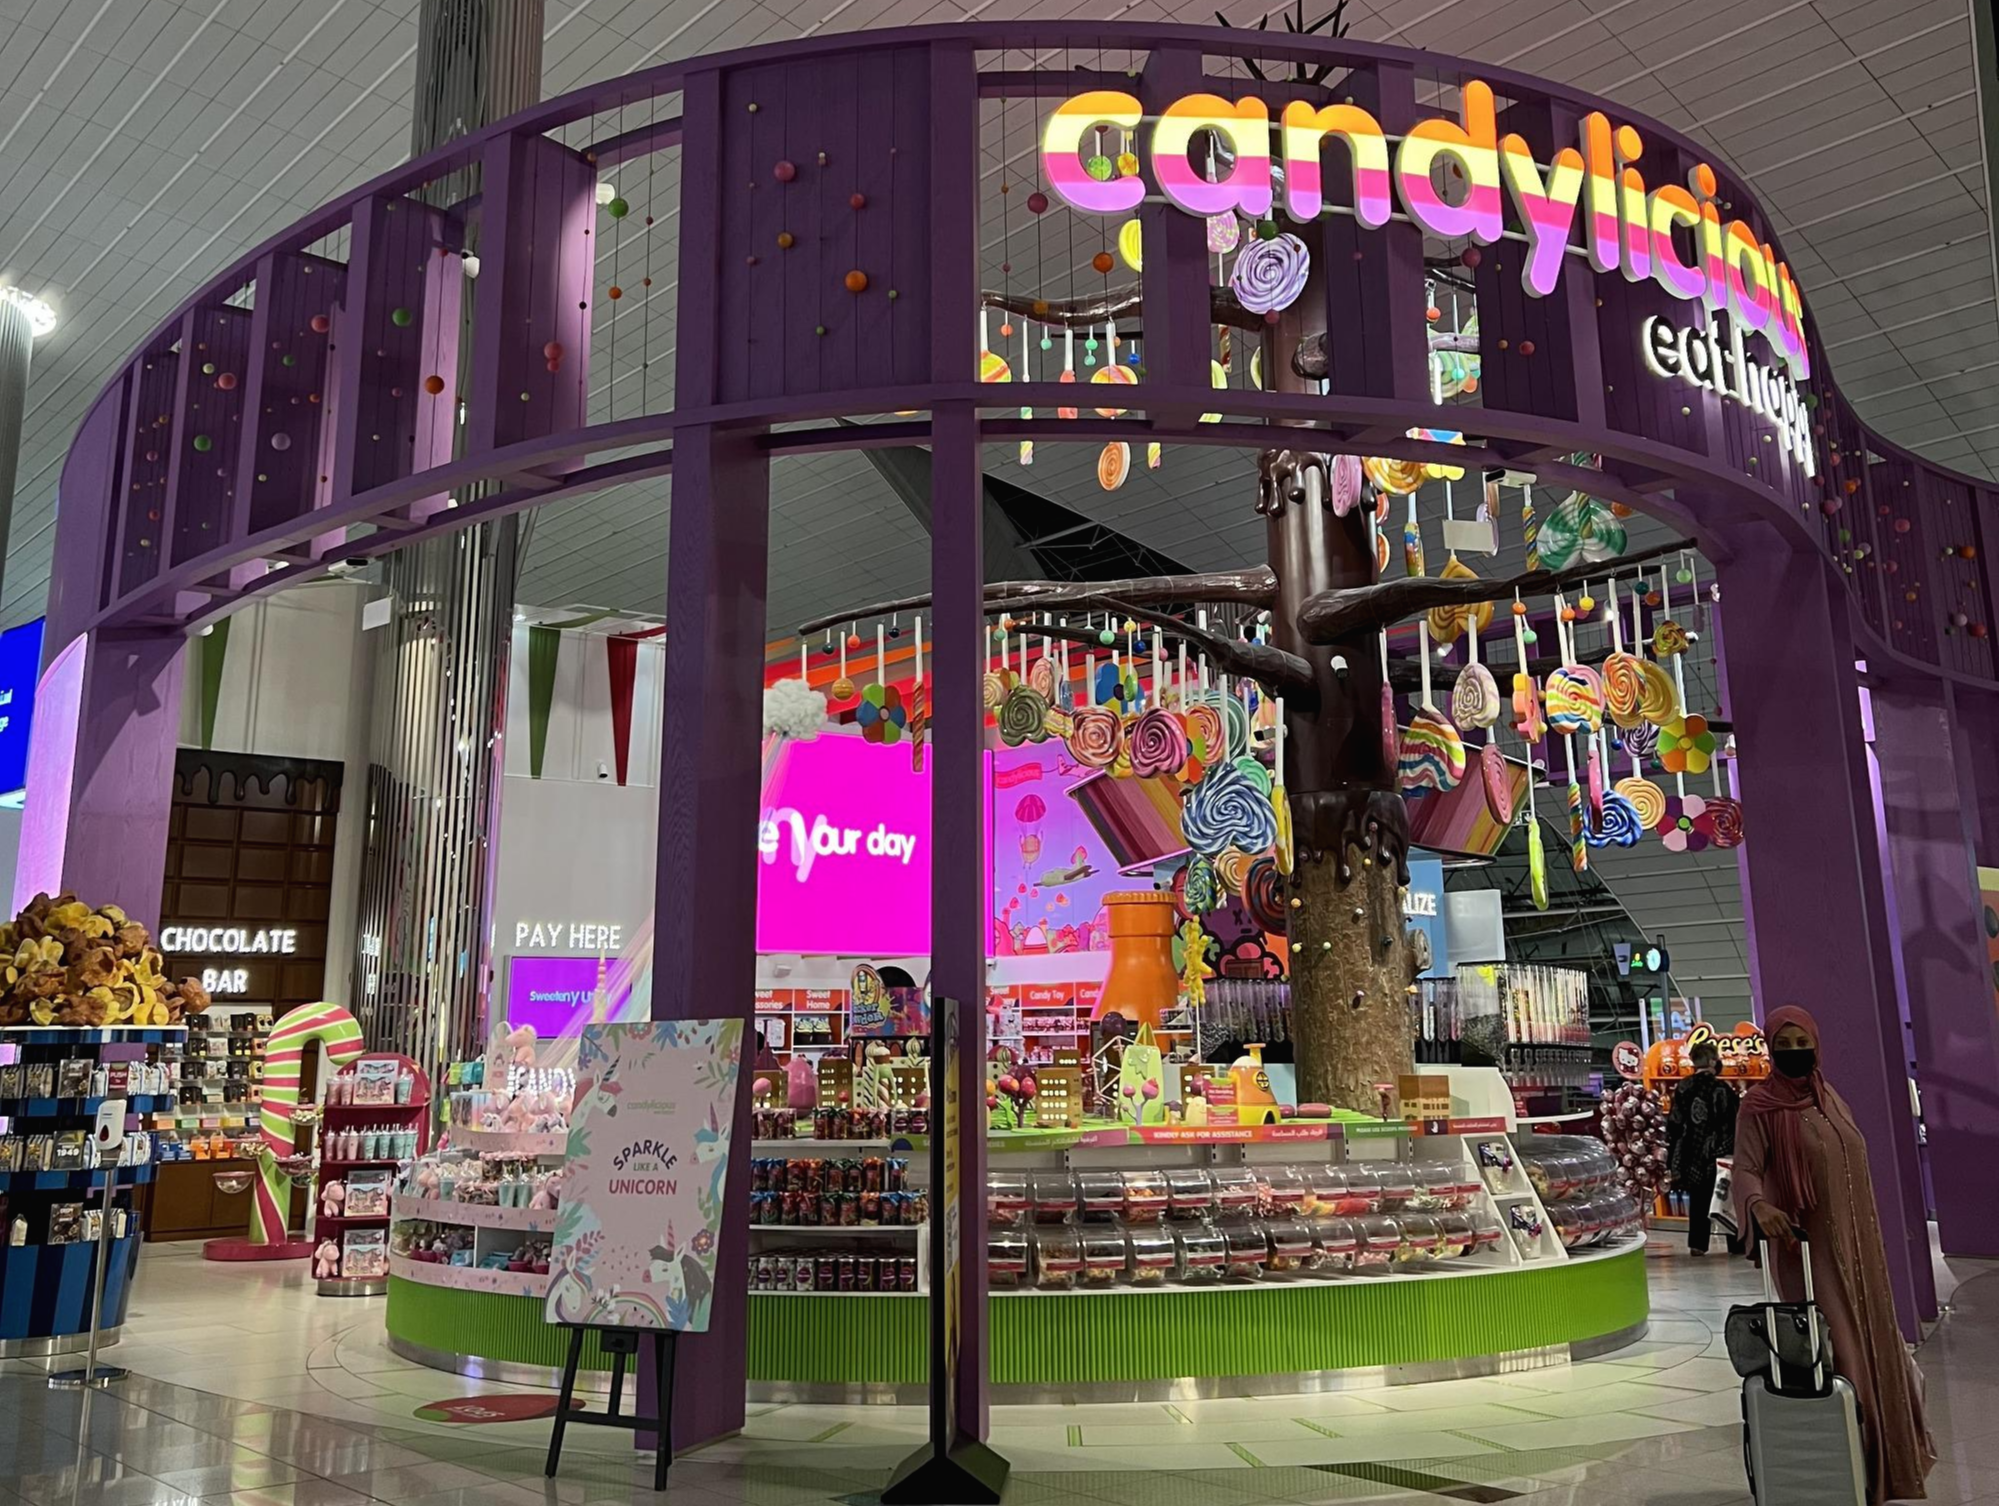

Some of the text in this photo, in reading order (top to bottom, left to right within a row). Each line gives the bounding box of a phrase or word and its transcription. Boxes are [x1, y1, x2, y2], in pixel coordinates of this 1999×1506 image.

[1042, 80, 1811, 380] candylicious
[1643, 314, 1739, 398] eat
[866, 823, 916, 865] day
[160, 927, 297, 953] CHOCOLATE
[515, 922, 622, 950] PAY HERE
[202, 968, 249, 994] BAR
[806, 990, 831, 999] Sweet
[806, 1000, 831, 1010] Home
[1029, 989, 1065, 1001] Candy Toy
[109, 1071, 128, 1079] PUSH
[1196, 1131, 1211, 1139] FOR
[1211, 1130, 1253, 1139] ASSISTANCE
[613, 1139, 678, 1171] SPARKLE
[633, 1162, 659, 1172] LIKE A
[608, 1179, 677, 1195] UNICORN
